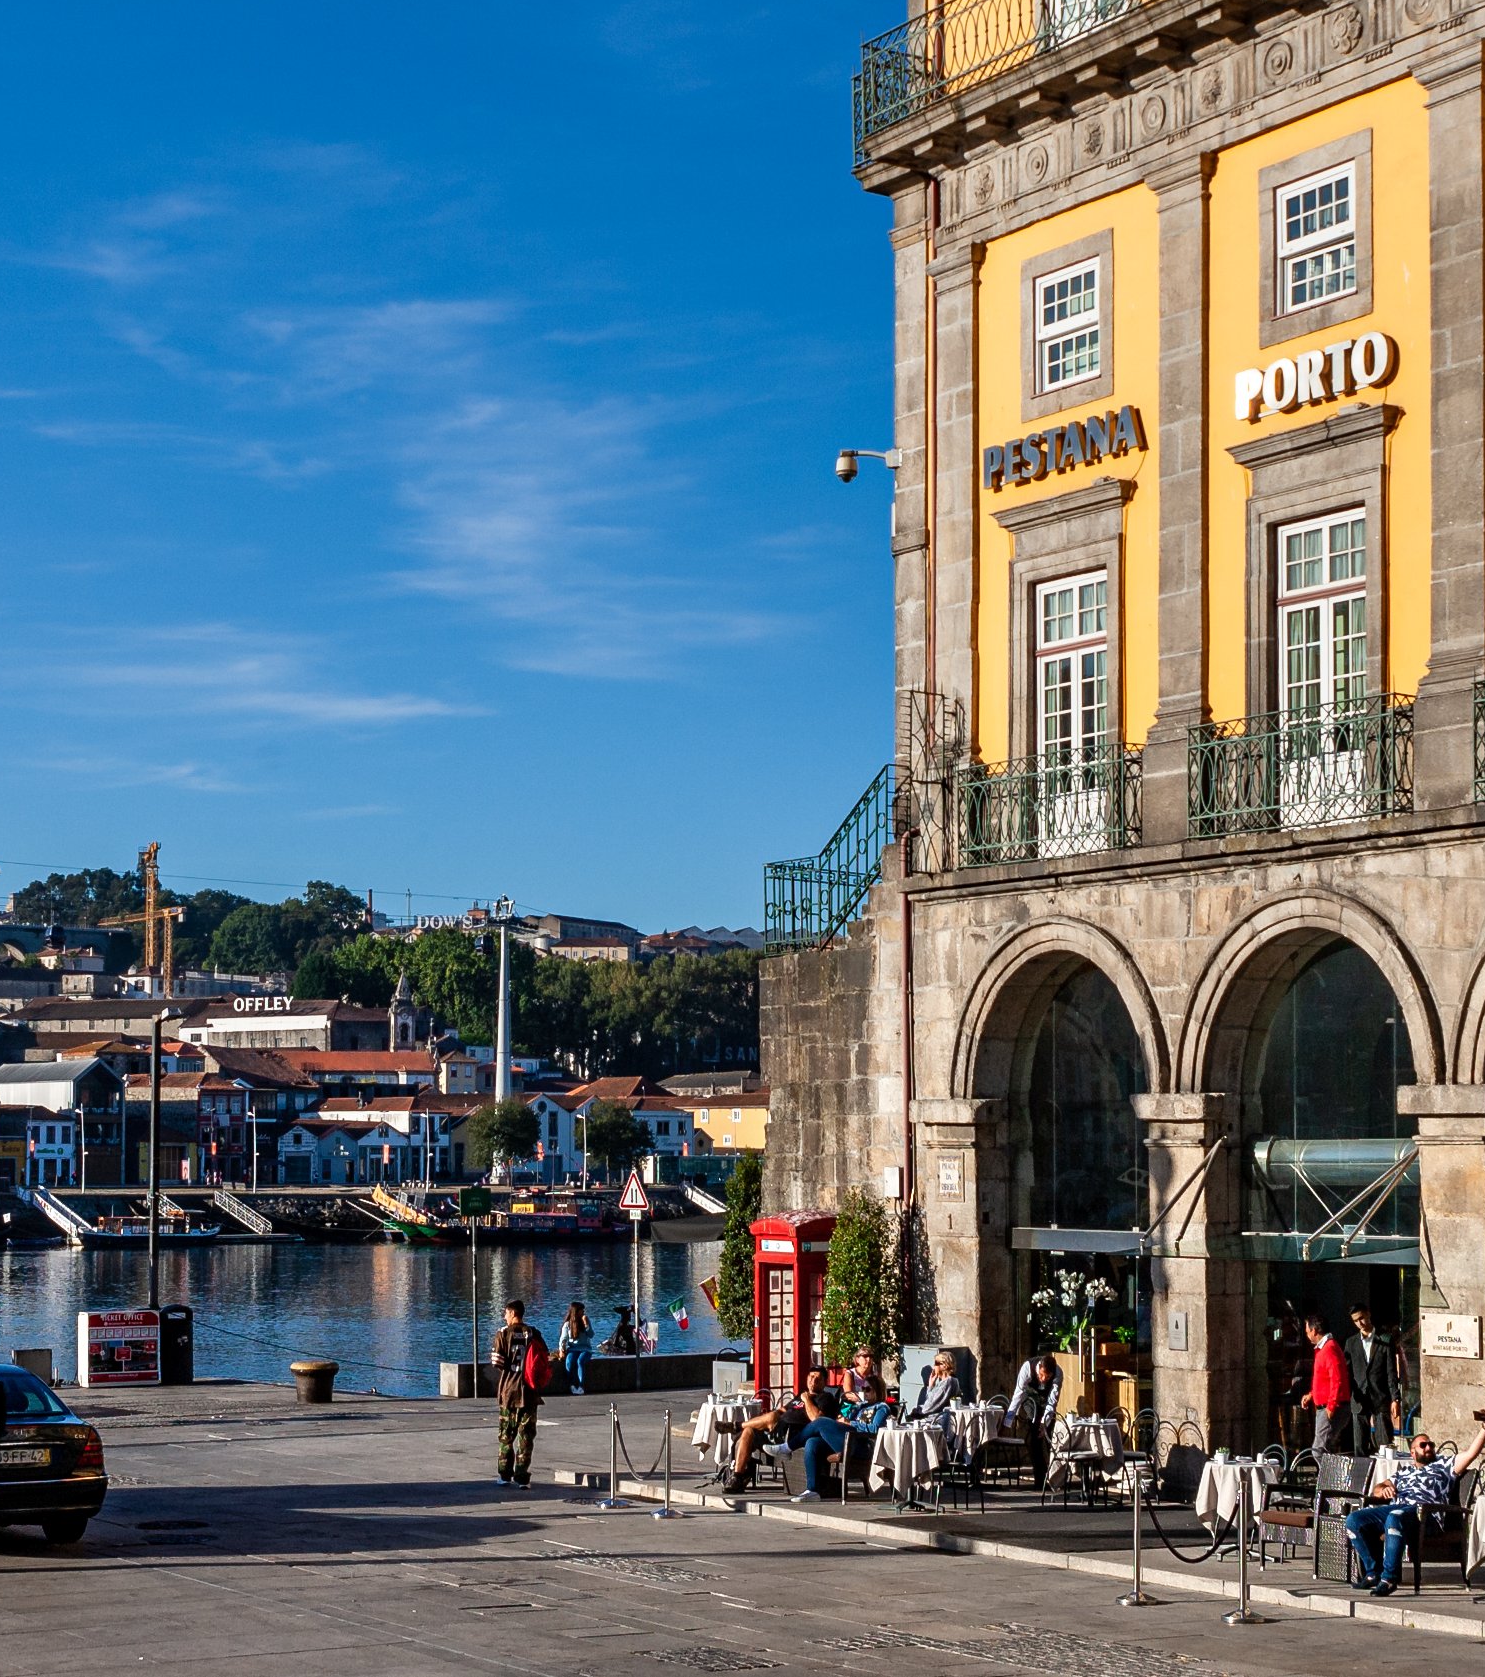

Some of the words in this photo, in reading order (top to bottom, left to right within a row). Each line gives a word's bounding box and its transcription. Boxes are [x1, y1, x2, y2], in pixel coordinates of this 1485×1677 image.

[983, 405, 1140, 489] PESTANA
[1235, 331, 1390, 421] PORTO
[417, 915, 473, 929] DOW'S
[233, 996, 294, 1012] OFFLEY
[948, 1213, 953, 1230] 1
[100, 1314, 122, 1322] TICKET
[123, 1313, 144, 1321] OFFICE
